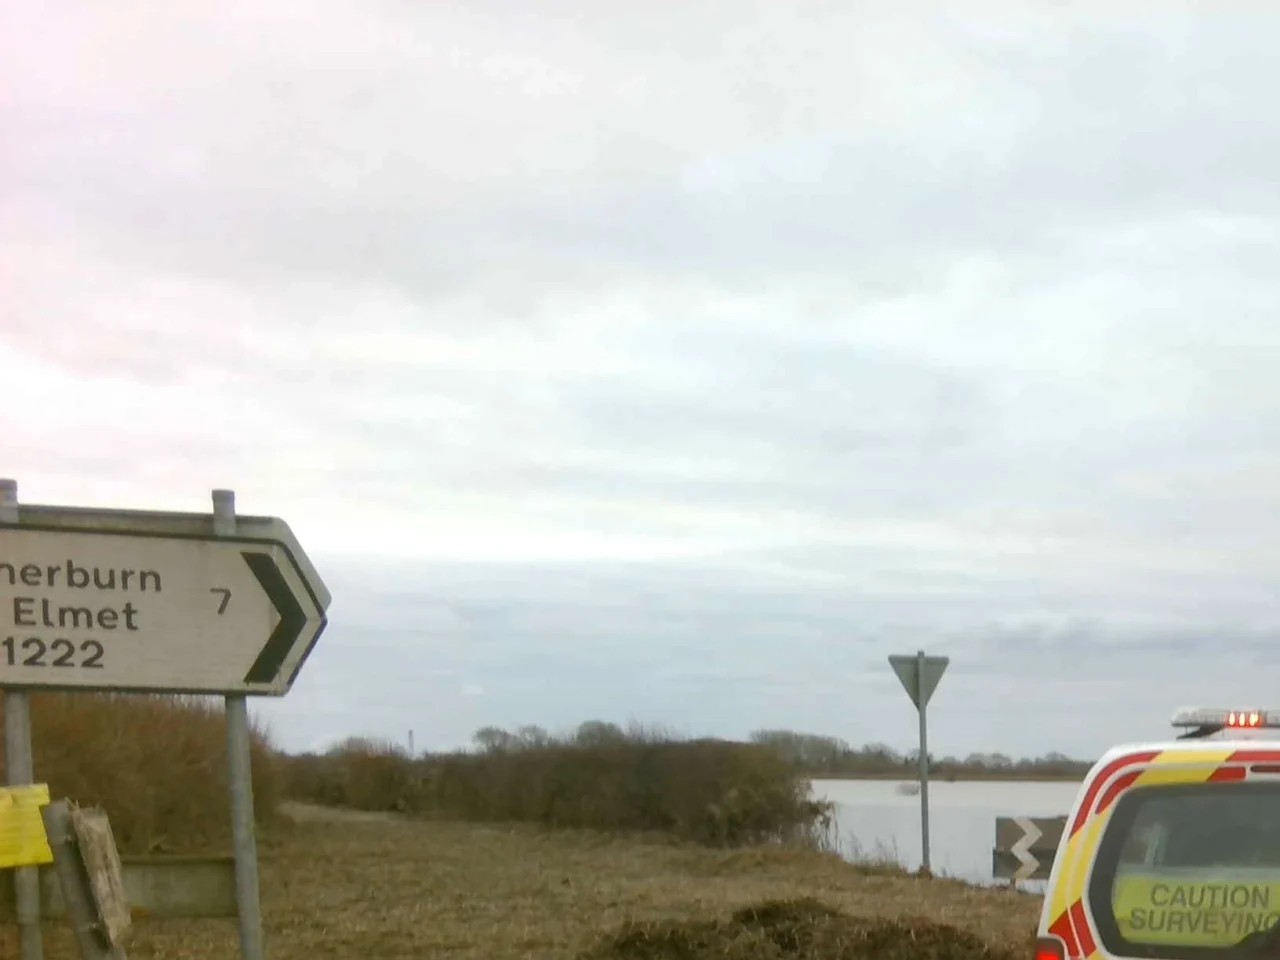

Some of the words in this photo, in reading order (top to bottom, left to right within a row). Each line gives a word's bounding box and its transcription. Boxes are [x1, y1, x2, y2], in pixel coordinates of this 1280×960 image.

[13, 597, 139, 630] Elmet
[210, 588, 232, 615] 7
[1151, 884, 1269, 909] CAUTION
